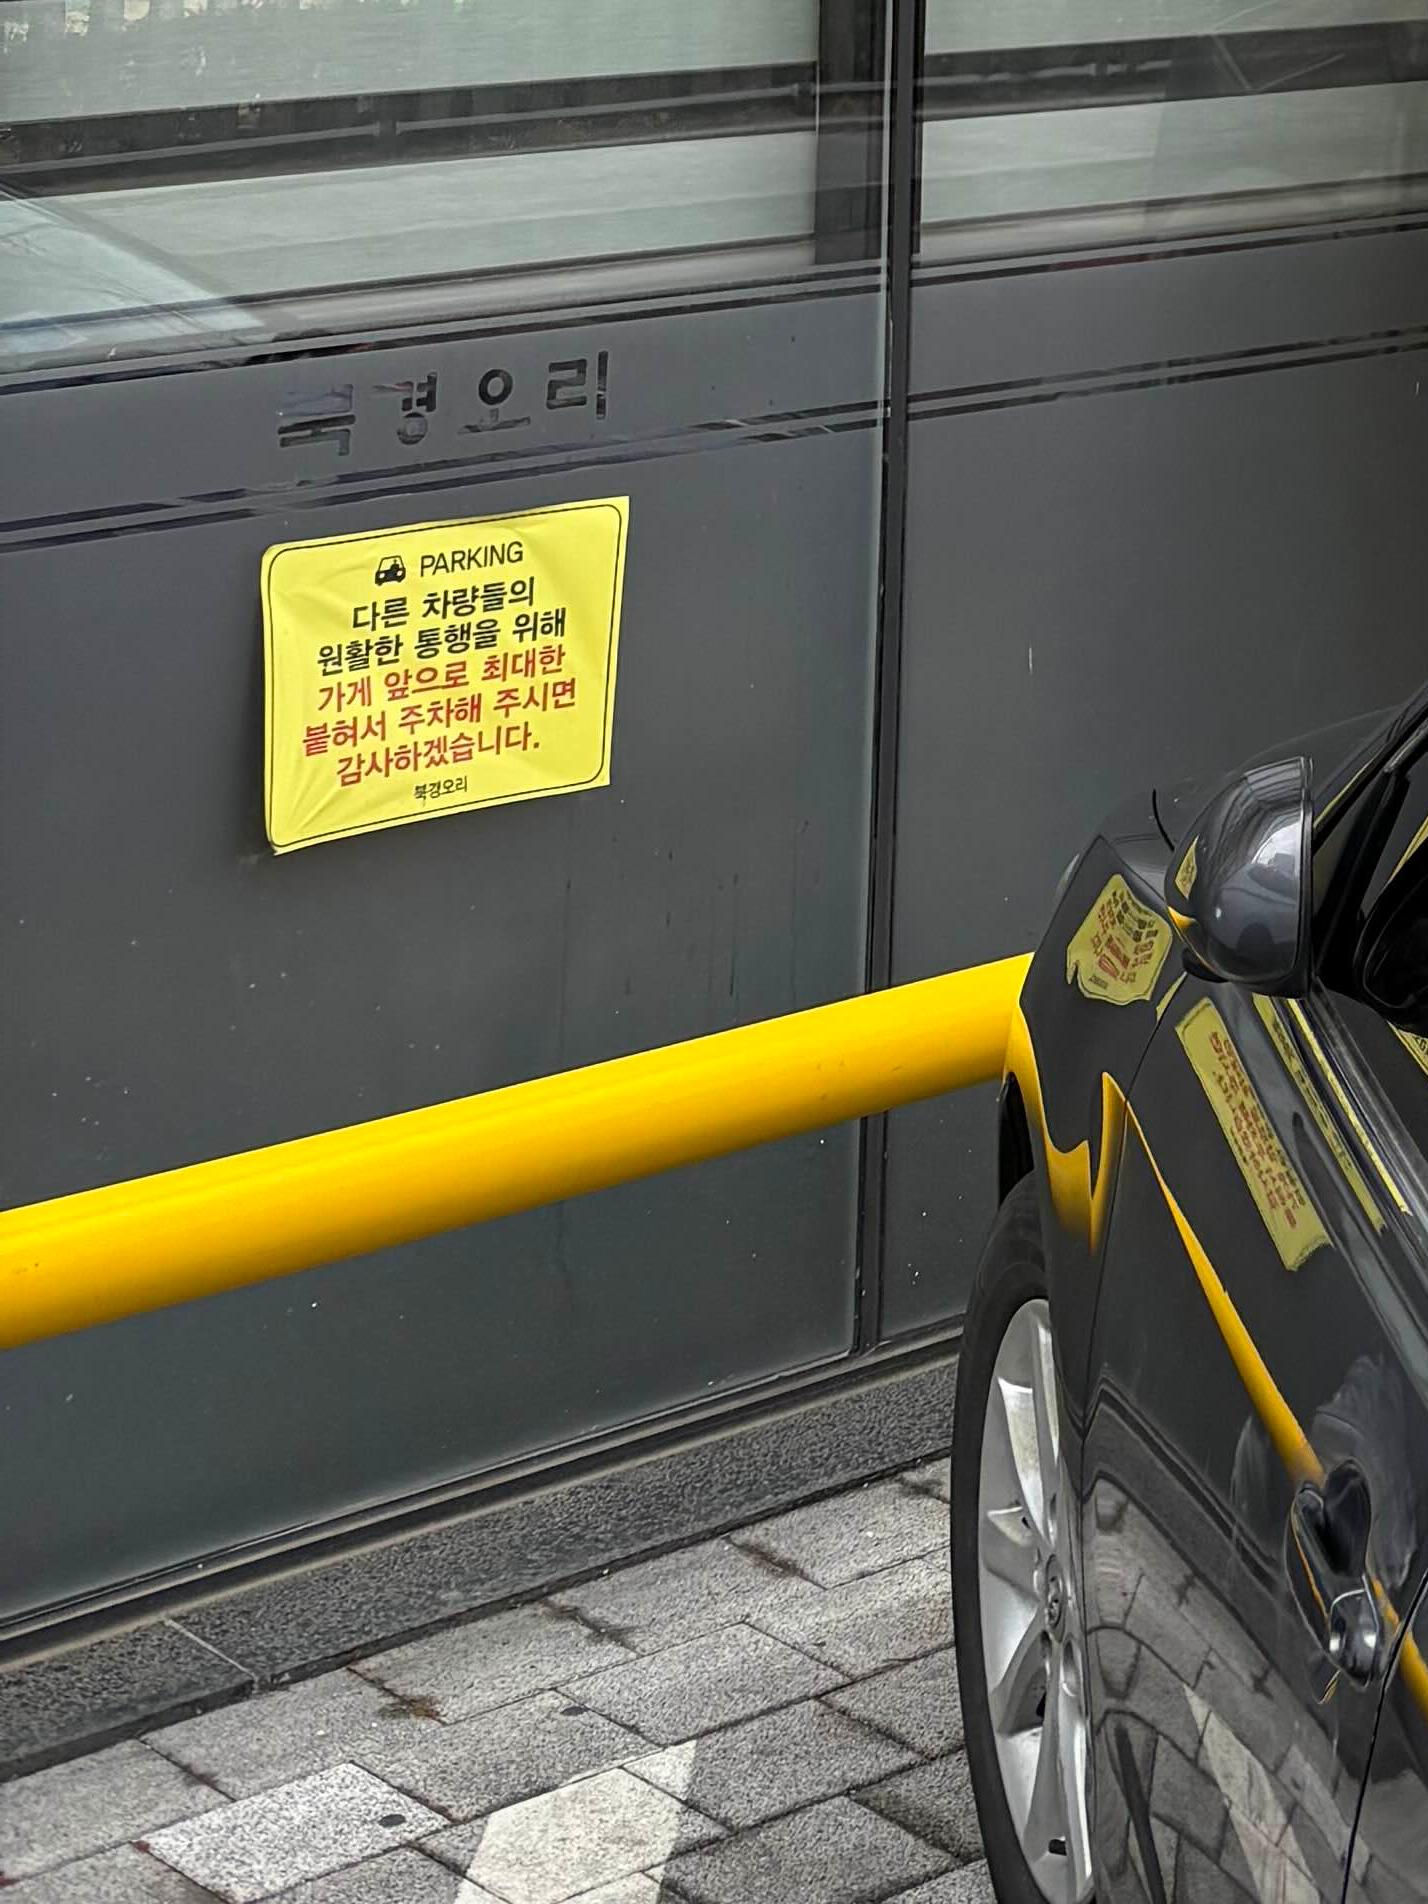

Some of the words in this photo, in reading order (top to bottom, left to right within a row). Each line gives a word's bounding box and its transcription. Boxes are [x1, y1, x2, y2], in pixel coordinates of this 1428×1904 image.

[420, 540, 525, 578] PARKING
[352, 595, 411, 634] 다른
[420, 576, 536, 623] 차량들의
[316, 632, 405, 677] 원활한
[413, 617, 503, 659] 통행을
[511, 607, 568, 645] 위해
[317, 675, 373, 714] 가게
[382, 664, 471, 703] 앞으로
[480, 644, 567, 687] 최대한
[397, 692, 483, 735] 주차해
[493, 677, 578, 719] 주시면
[336, 726, 542, 789] 감사하겠습니다.
[413, 775, 469, 807] 북경오리
